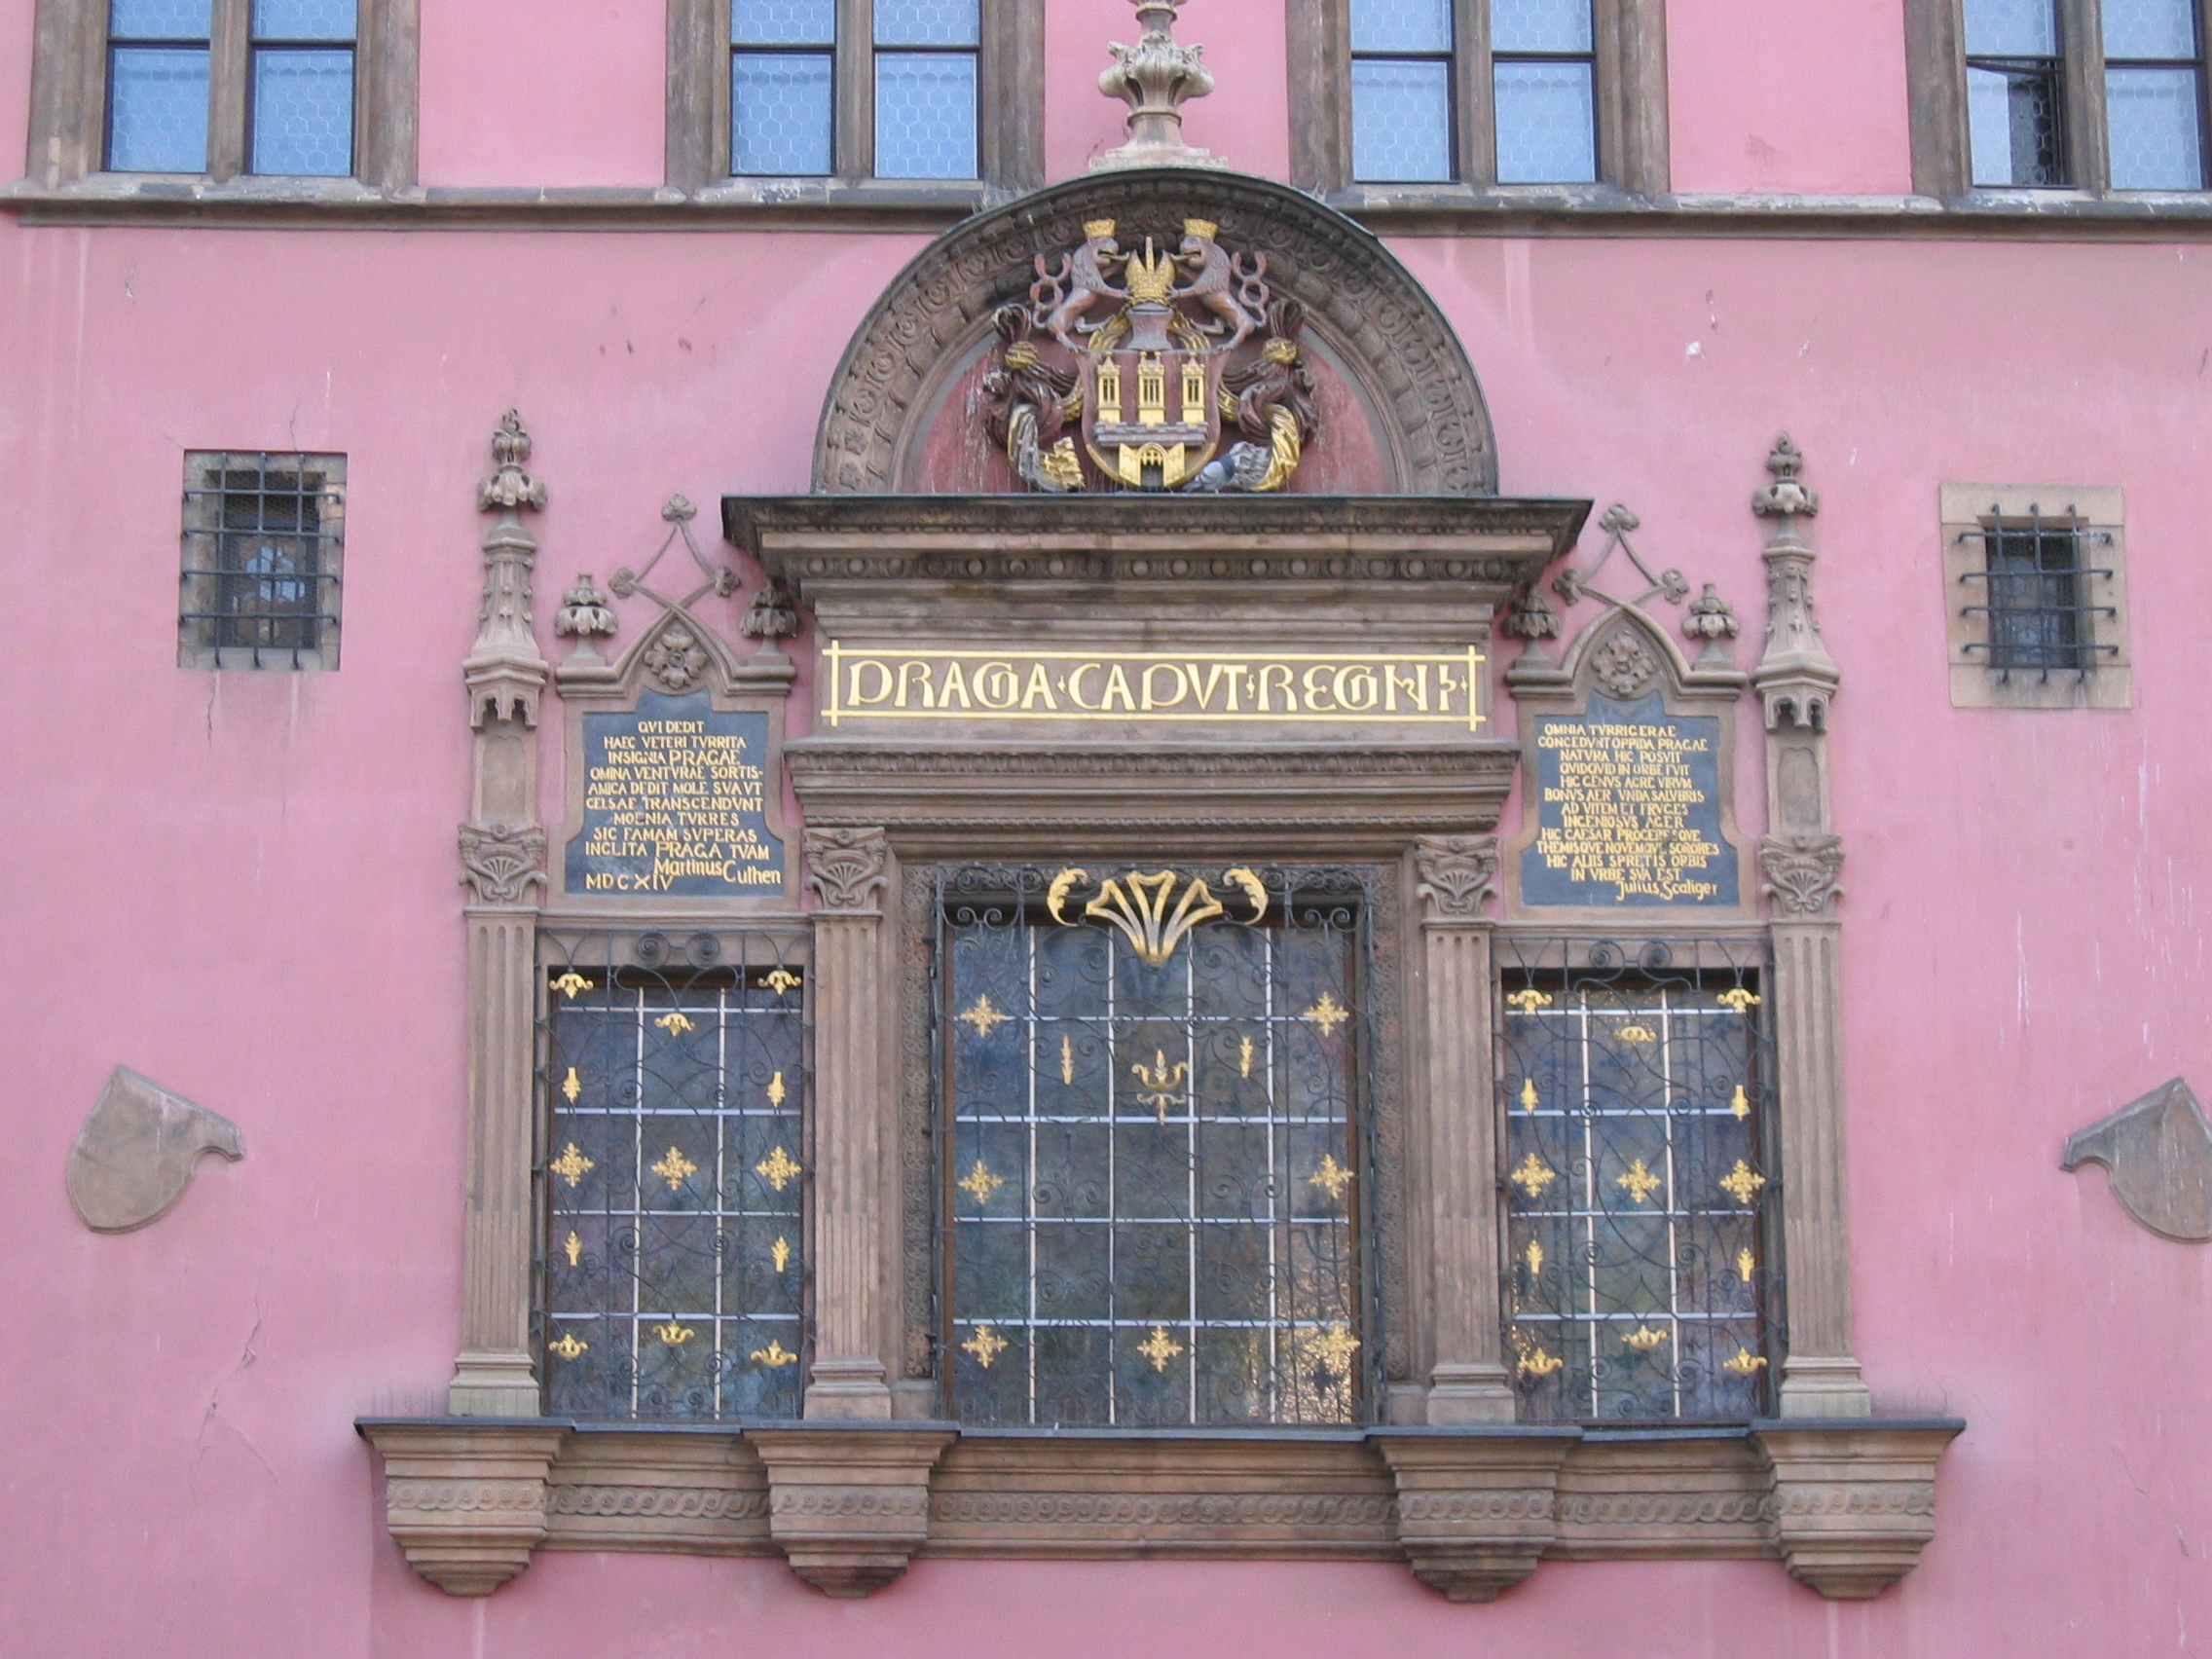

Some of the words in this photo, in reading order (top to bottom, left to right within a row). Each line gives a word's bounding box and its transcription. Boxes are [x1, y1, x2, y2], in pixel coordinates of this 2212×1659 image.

[639, 721, 662, 733] QVI
[666, 720, 704, 733] DEDIT
[1545, 723, 1586, 735] OMNIA
[605, 737, 635, 748] HAEC
[643, 736, 686, 748] VETERI
[691, 737, 746, 748] TVRRITA
[608, 752, 666, 763] INSIGNIA
[669, 750, 740, 765] PRAGAE
[1560, 750, 1609, 762] NATVRA
[1615, 751, 1634, 762] HIC
[634, 766, 705, 779] VENTVRAE
[1618, 764, 1631, 775] IN
[1561, 776, 1581, 787] HIC
[631, 782, 668, 794] DEDIT
[673, 783, 708, 794] MOLE
[714, 782, 741, 794] SVA
[745, 783, 762, 794] VT
[586, 797, 637, 810] CELSAE
[643, 796, 763, 811] TRANSCENDVNT
[1562, 802, 1579, 814] AD
[677, 813, 739, 826] TVRRES
[593, 829, 616, 841] SIC
[624, 829, 678, 841] FAMAM
[683, 829, 757, 842] SVPERAS
[1542, 828, 1561, 840] HIC
[585, 842, 647, 857] INCLITA
[655, 841, 723, 859] PRAGA
[729, 845, 769, 860] TVAM
[1547, 855, 1567, 867] HIC
[1571, 868, 1586, 881] IN
[1590, 868, 1626, 881] VRBE
[1657, 868, 1682, 881] EST
